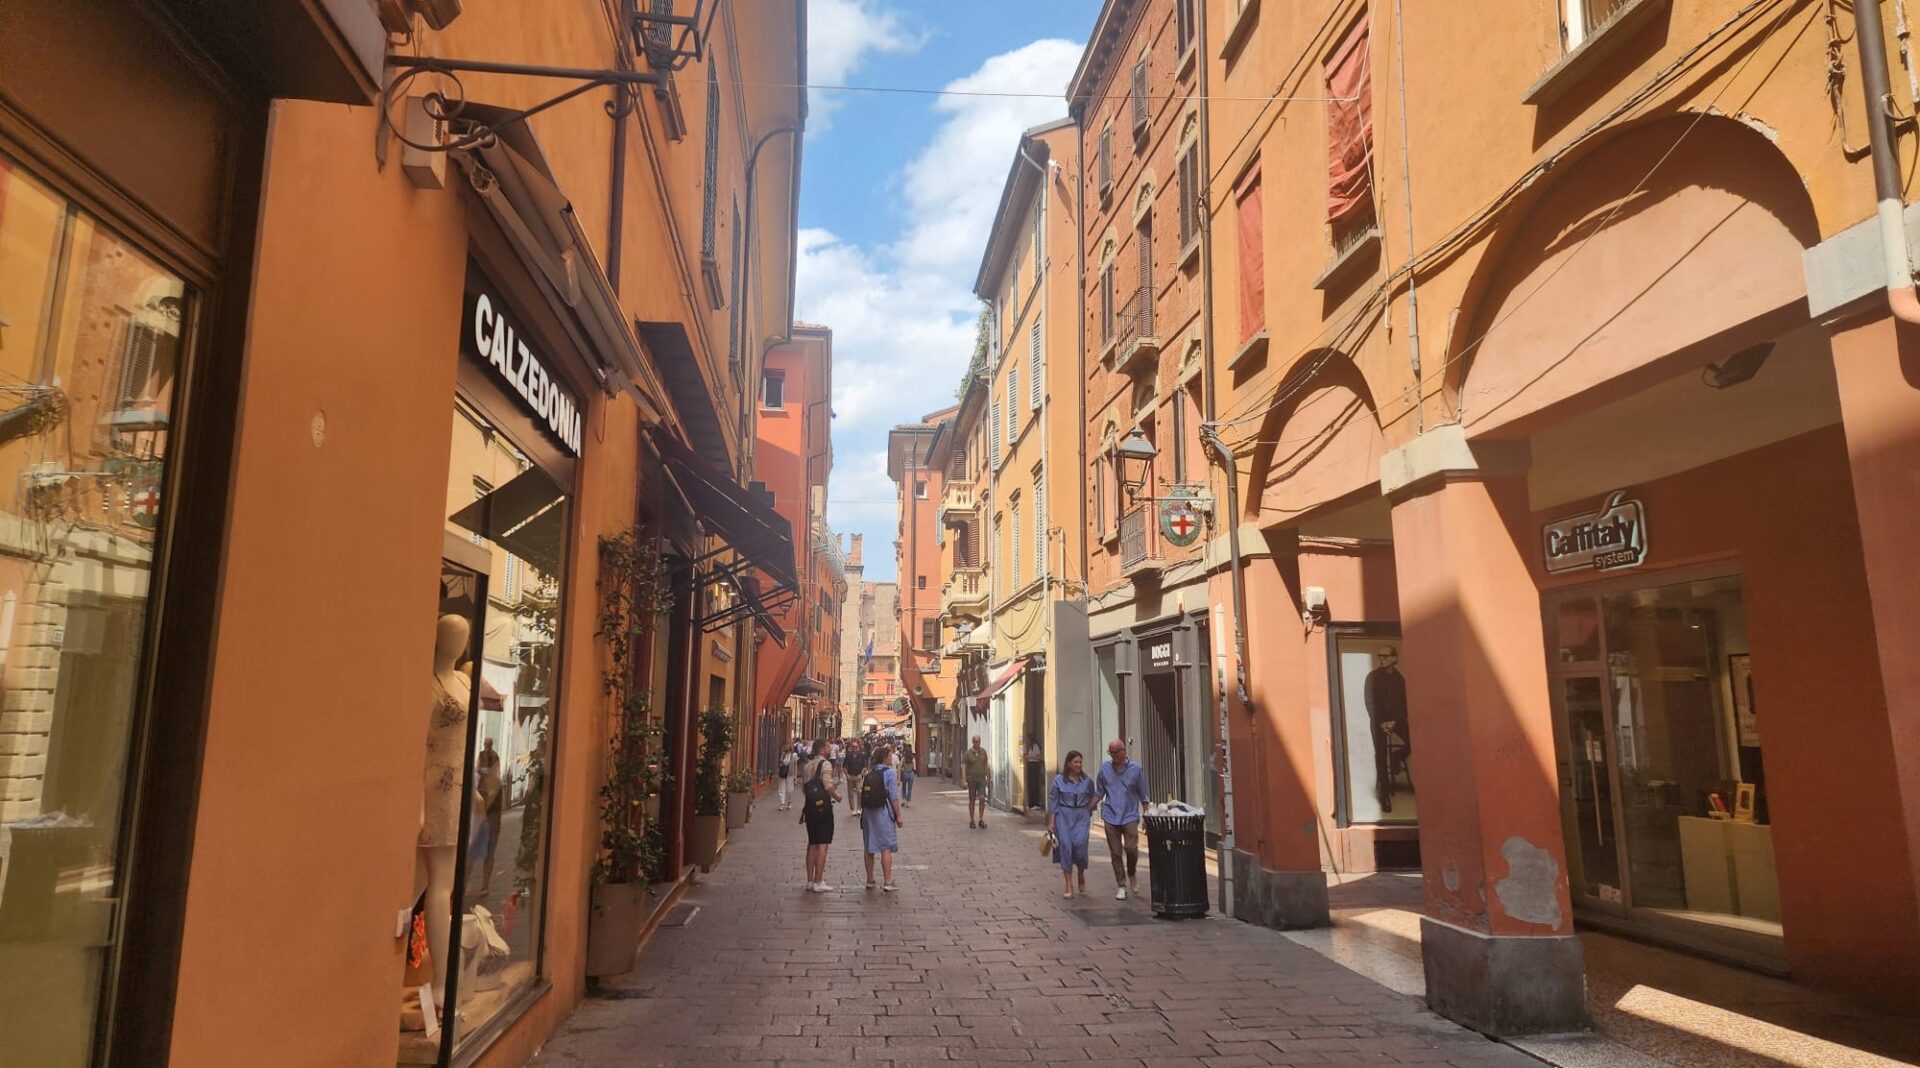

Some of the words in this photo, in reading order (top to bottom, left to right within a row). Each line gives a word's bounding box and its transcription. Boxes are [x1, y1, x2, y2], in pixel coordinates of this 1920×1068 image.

[475, 293, 581, 458] CALZEDONIA
[1546, 515, 1634, 558] Caffitaly
[1594, 550, 1634, 569] system
